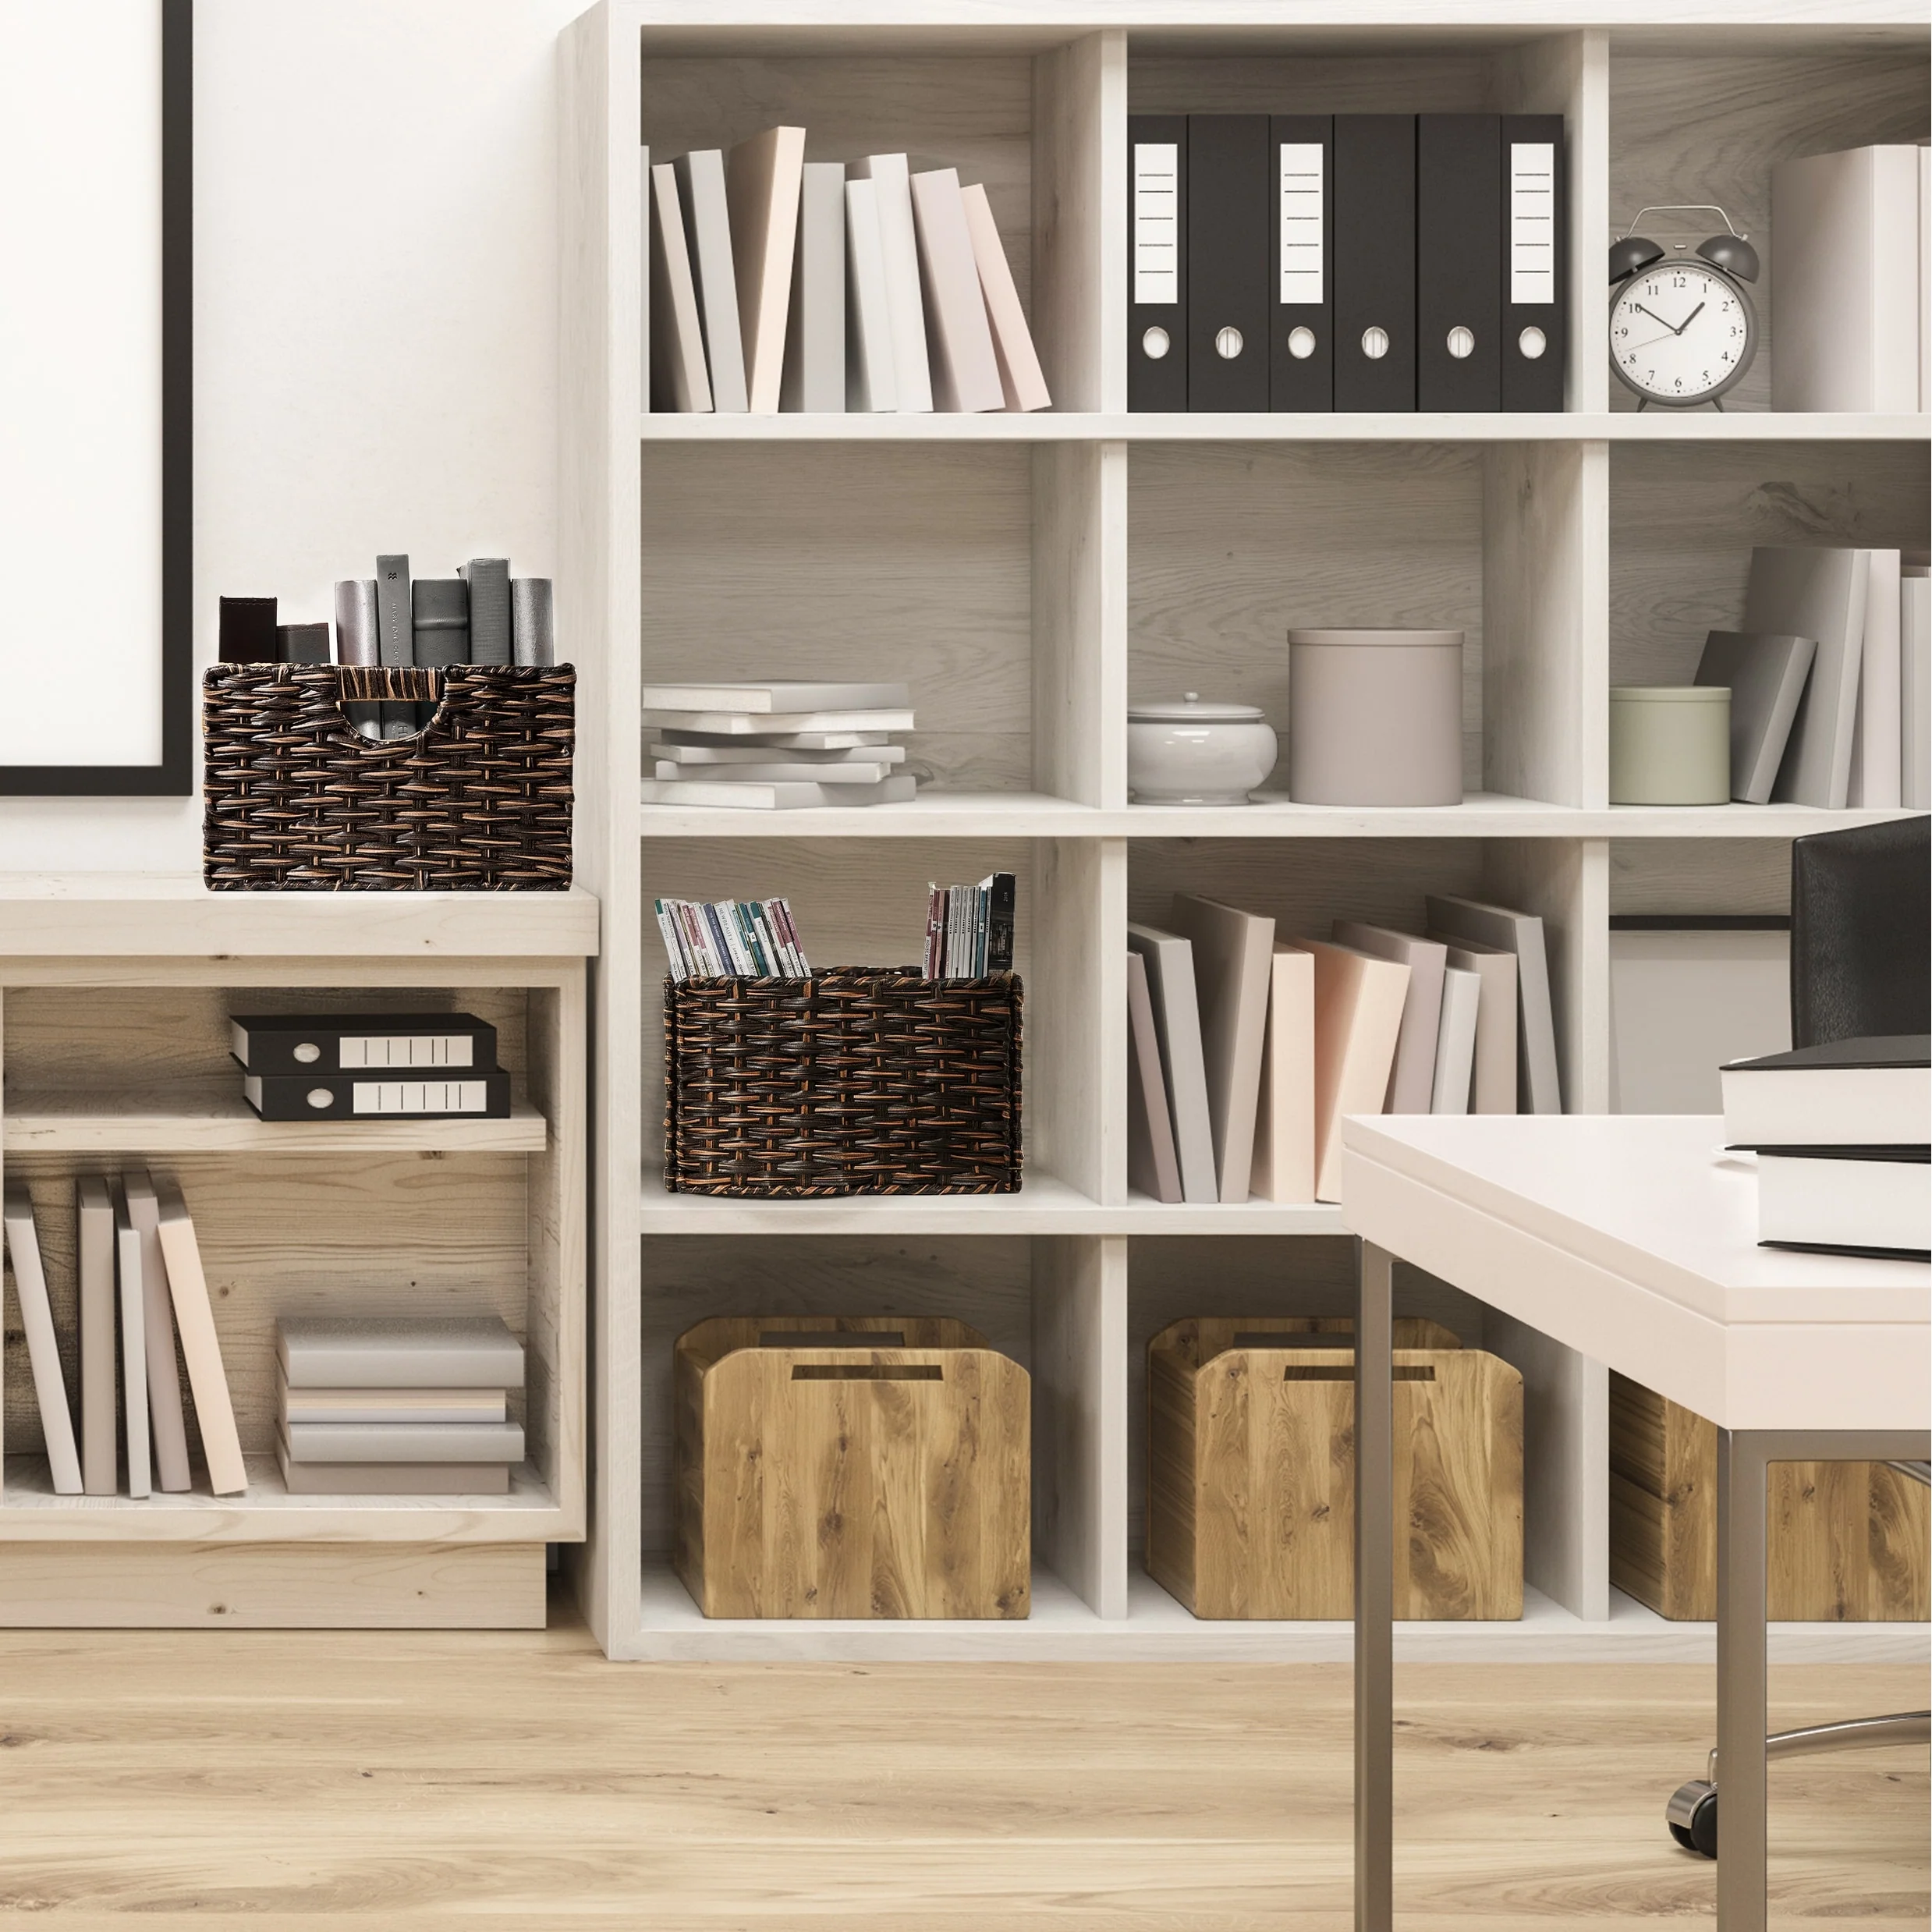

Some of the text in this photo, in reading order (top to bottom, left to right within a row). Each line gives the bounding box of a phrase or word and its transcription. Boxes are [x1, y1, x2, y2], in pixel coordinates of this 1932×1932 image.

[1673, 276, 1686, 288] 12
[1647, 285, 1659, 296] 11
[1703, 283, 1707, 293] 1
[1722, 301, 1729, 312] 2
[1621, 327, 1629, 339] 9
[1730, 326, 1736, 337] 3
[1629, 353, 1636, 364] 8
[1721, 351, 1728, 361] 4
[1648, 370, 1655, 381] 7
[1702, 370, 1709, 381] 5
[1674, 378, 1682, 388] 6
[718, 907, 733, 941] NEWBEAUTY
